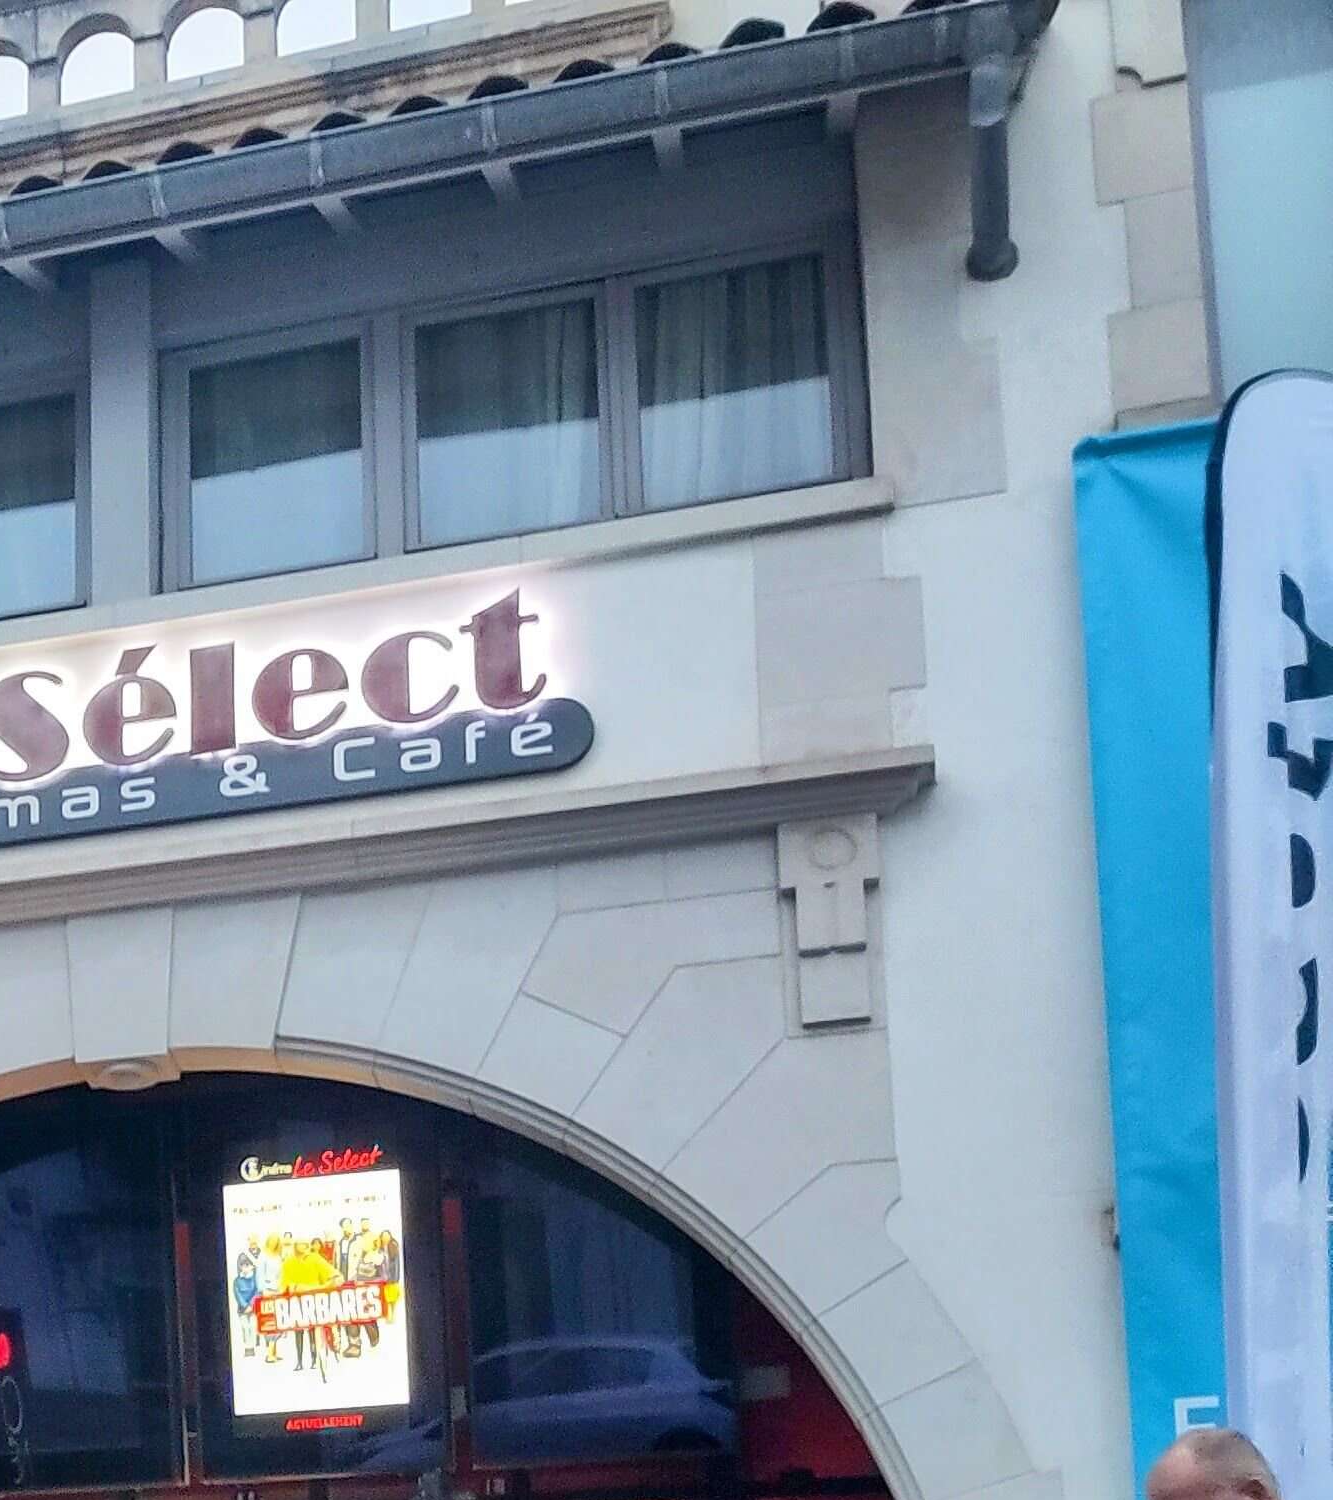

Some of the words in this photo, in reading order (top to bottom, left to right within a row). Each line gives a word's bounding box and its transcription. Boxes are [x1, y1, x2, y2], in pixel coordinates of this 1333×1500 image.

[218, 755, 270, 797] &
[332, 713, 555, 781] Café
[275, 1285, 382, 1330] BARBARES
